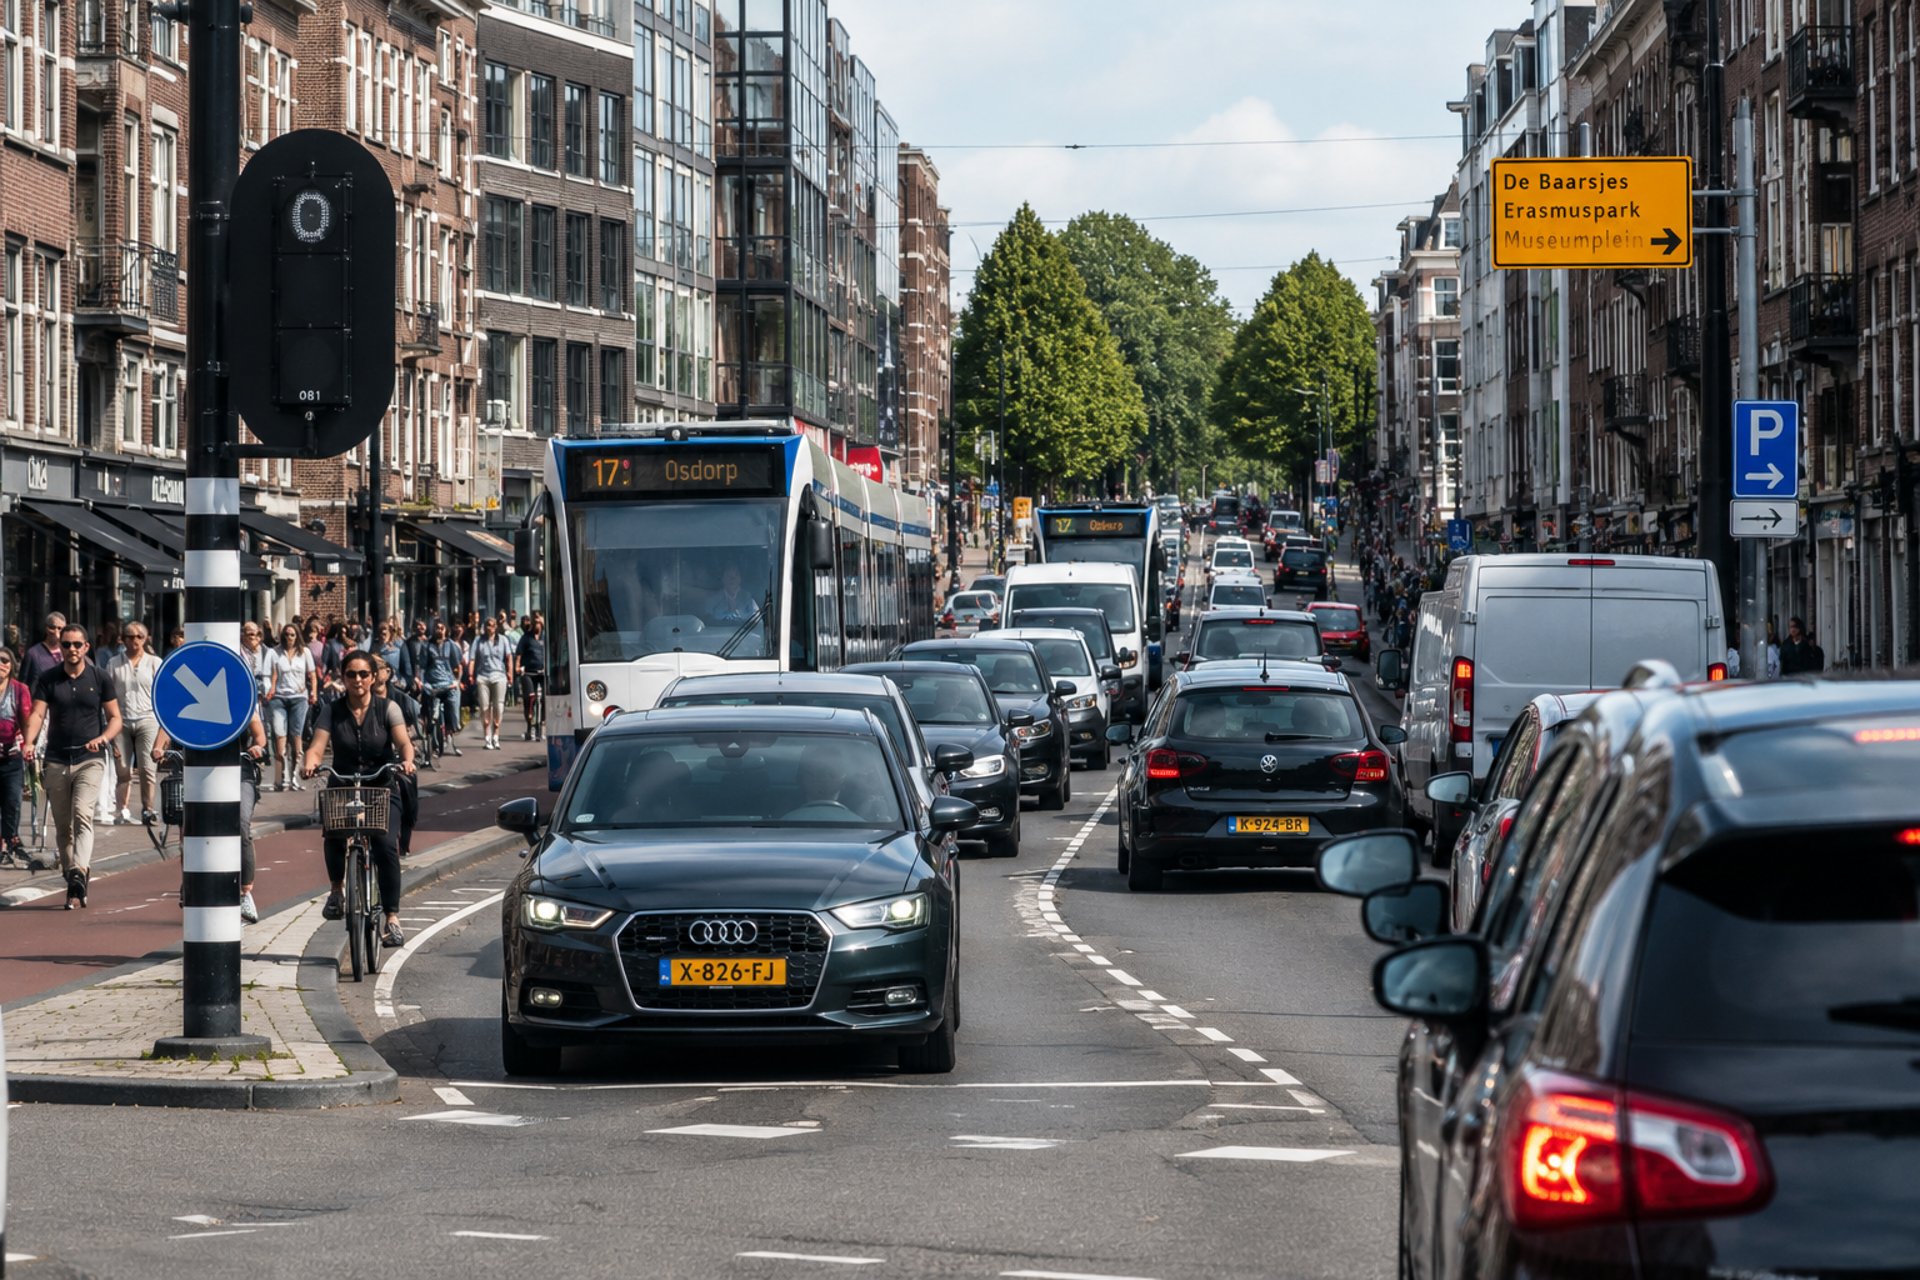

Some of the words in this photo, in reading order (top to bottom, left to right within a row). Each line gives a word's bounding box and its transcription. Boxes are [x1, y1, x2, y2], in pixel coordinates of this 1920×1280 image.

[1504, 174, 1529, 190] De
[1539, 173, 1628, 194] Baarsjes
[1504, 201, 1641, 223] Erasmuspark
[1504, 230, 1643, 254] Museumplein
[299, 390, 321, 401] 081
[1750, 409, 1784, 456] P
[665, 459, 738, 486] Osdorp
[679, 962, 775, 982] X-826-FJ
